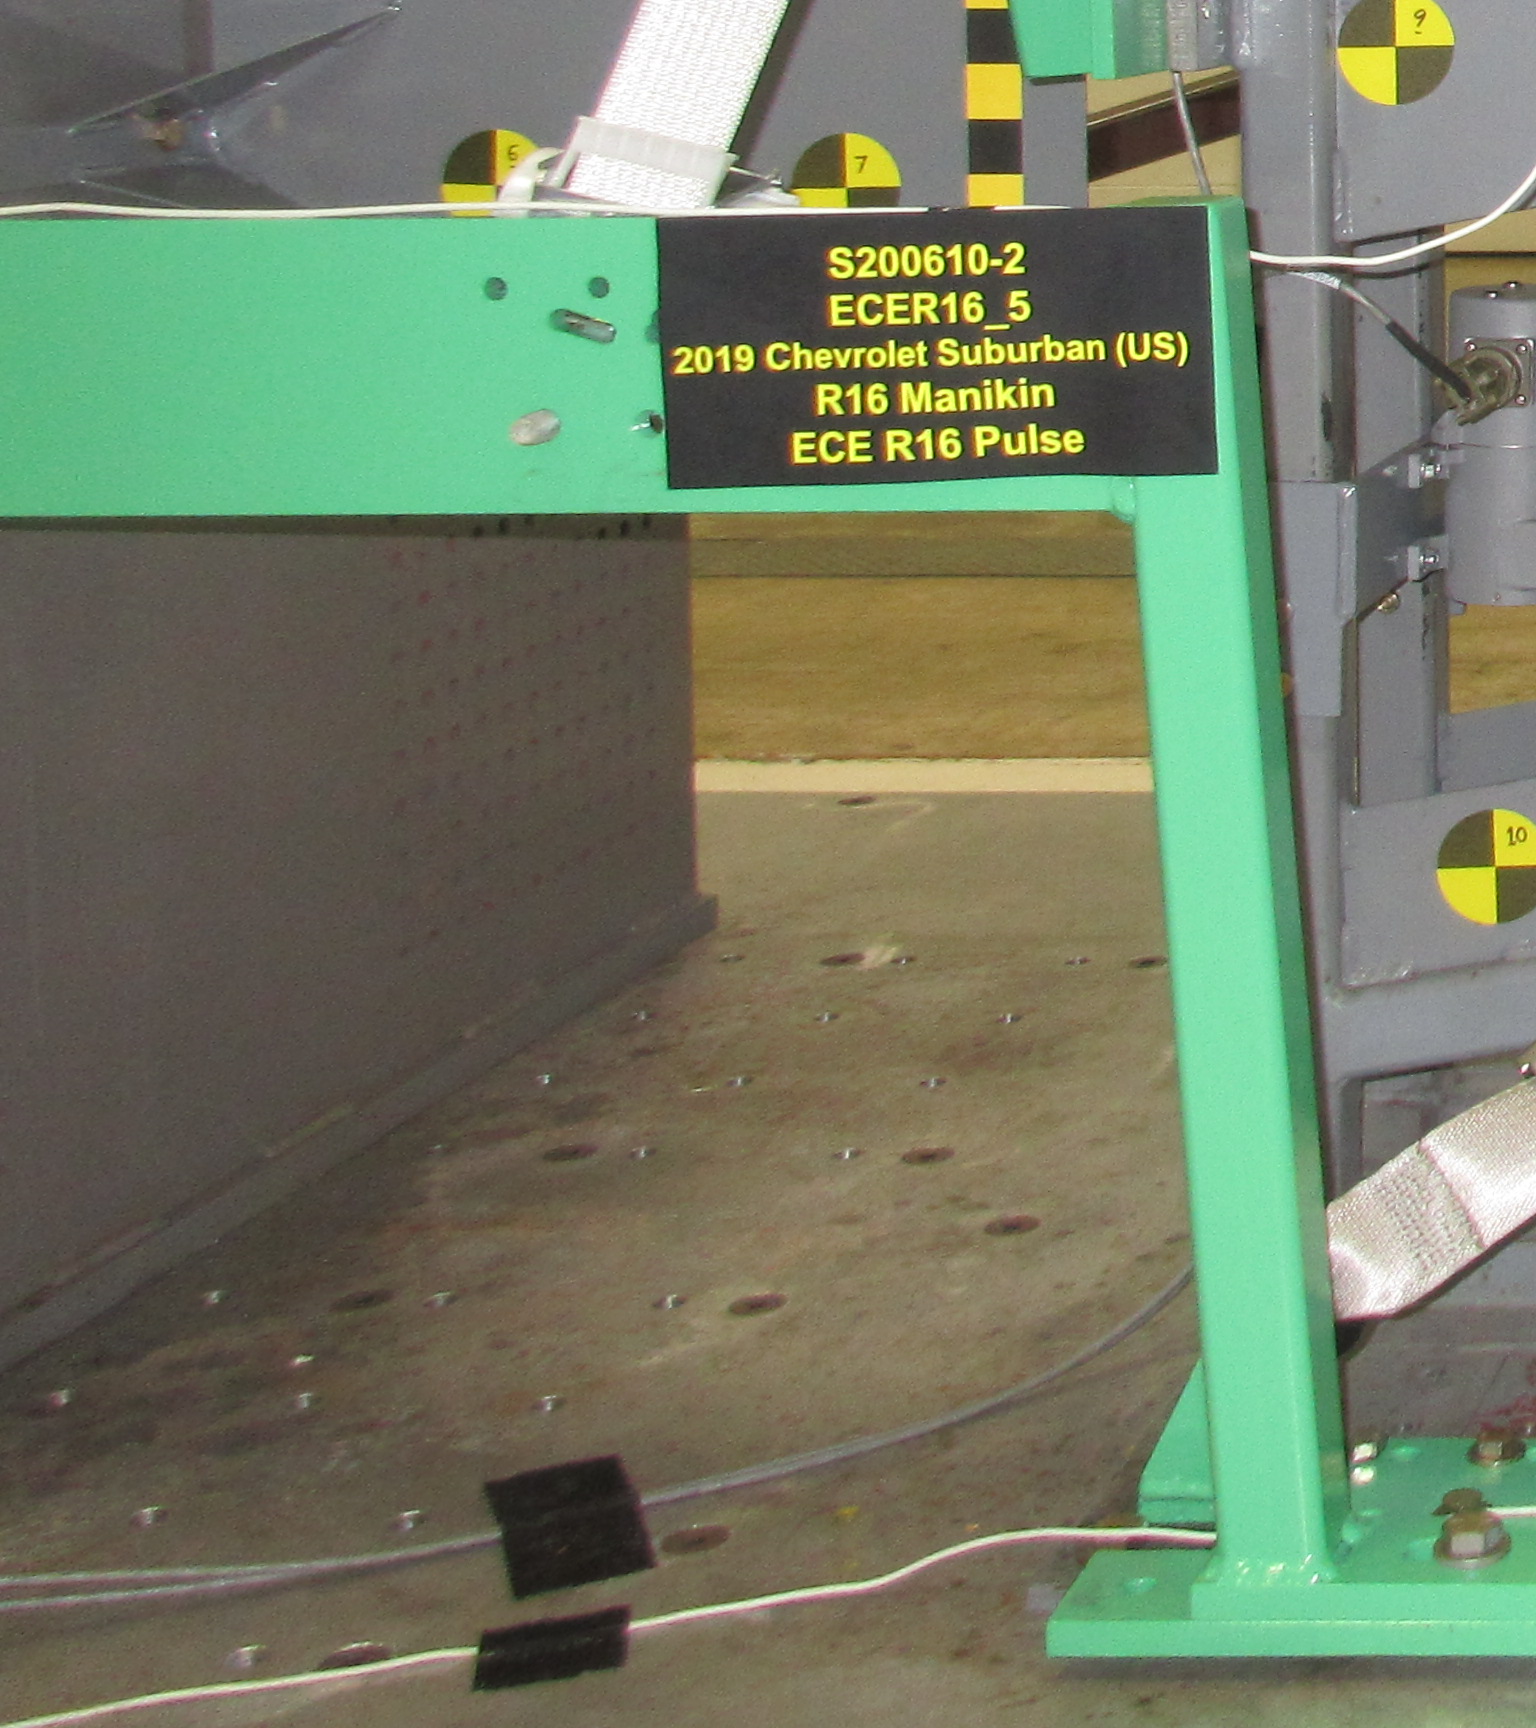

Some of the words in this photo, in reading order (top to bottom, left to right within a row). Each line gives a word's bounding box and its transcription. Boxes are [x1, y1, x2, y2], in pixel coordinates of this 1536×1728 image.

[1413, 8, 1427, 29] 9
[853, 154, 869, 174] 7
[827, 242, 1026, 280] S200610-2
[828, 290, 1031, 331] ECER16_5
[672, 344, 755, 375] 2019
[764, 338, 928, 371] Chevrolet
[936, 333, 1106, 367] Suburban
[1115, 330, 1188, 369] (US)
[815, 382, 889, 417] R16
[899, 376, 1055, 414] Manikin
[791, 430, 873, 465] ECE
[885, 427, 962, 462] R16
[973, 422, 1086, 458] Pulse
[1505, 825, 1528, 847] 10
